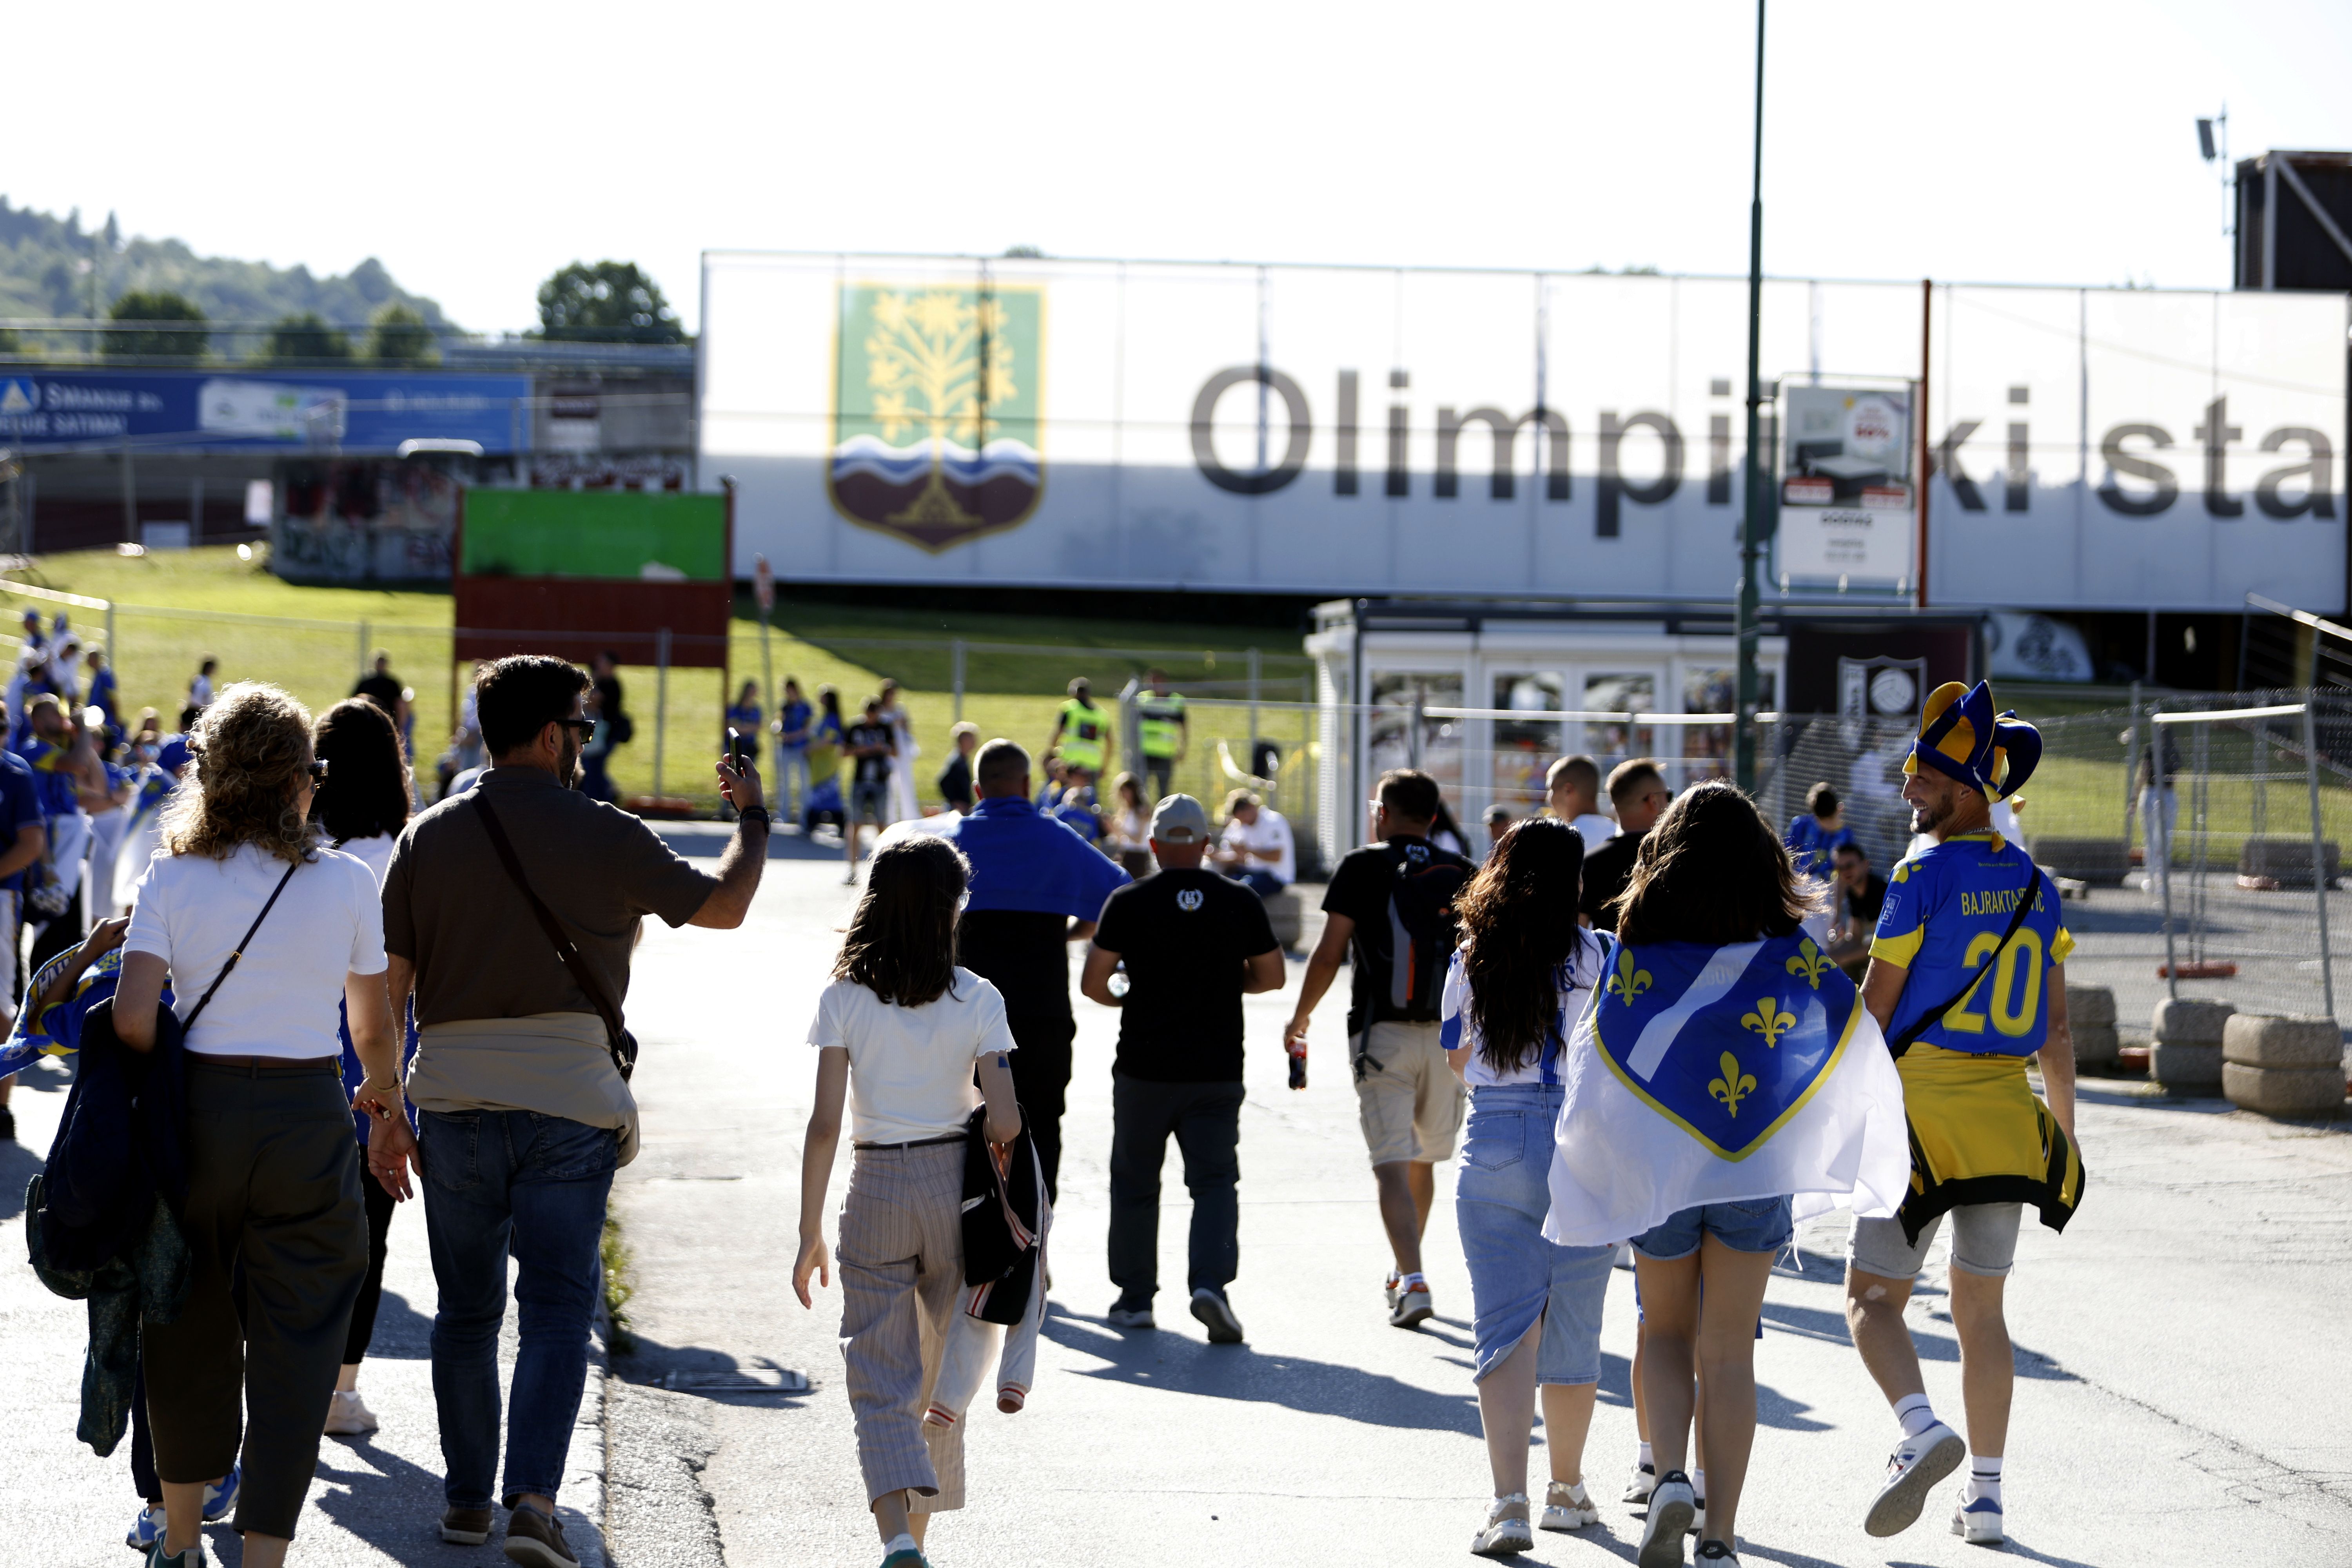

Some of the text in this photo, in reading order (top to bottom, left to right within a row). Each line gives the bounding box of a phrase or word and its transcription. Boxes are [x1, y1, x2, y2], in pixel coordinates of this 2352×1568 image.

[1188, 365, 2337, 542] Olimpiki sta
[1961, 886, 2045, 916] BAJRAKTAIĆ
[1942, 927, 2042, 1038] 20
